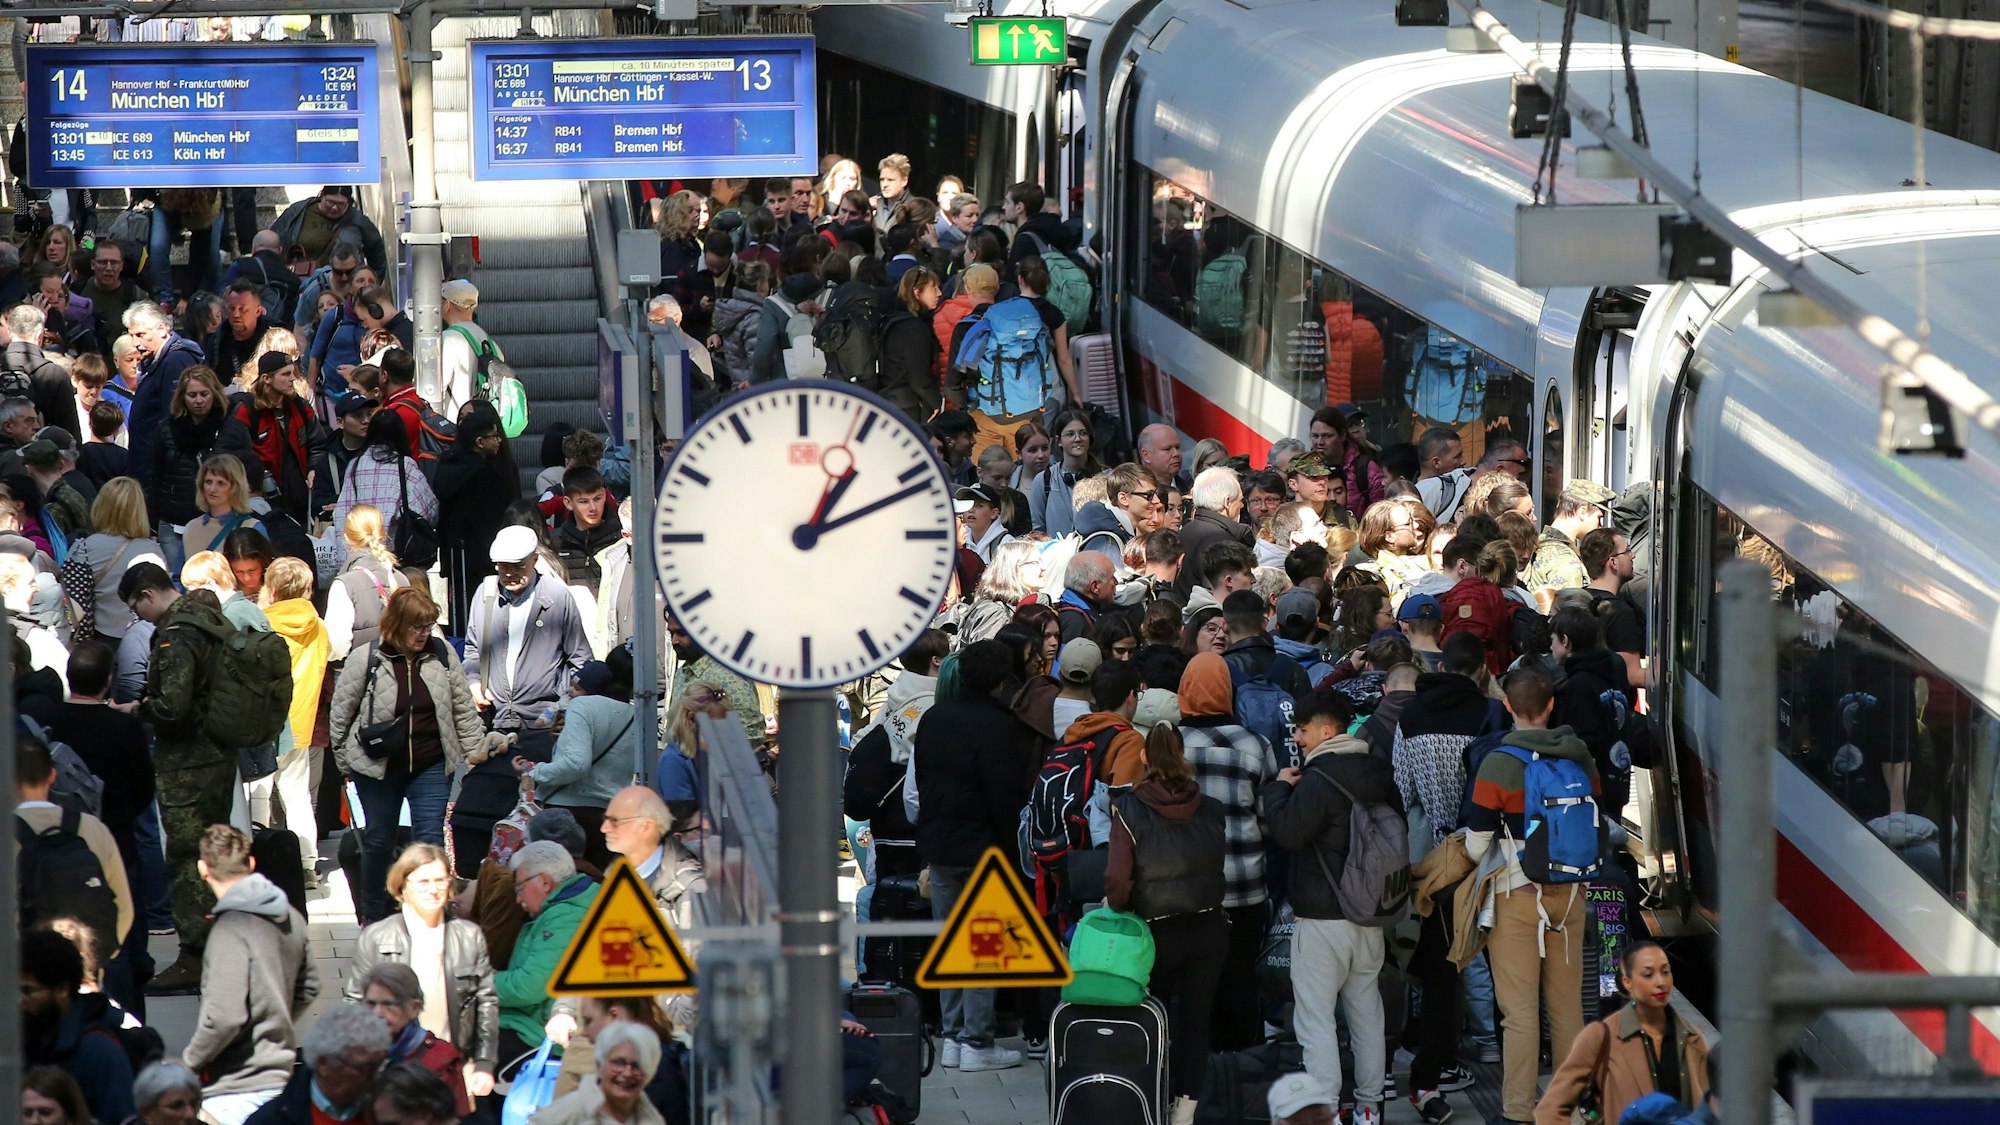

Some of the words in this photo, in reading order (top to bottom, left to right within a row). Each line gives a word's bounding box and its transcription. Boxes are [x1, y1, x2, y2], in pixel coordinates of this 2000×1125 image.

[496, 64, 529, 78] 13:01
[621, 62, 636, 70] ca.
[640, 61, 650, 69] 10
[653, 60, 694, 69] Minuten
[320, 67, 355, 81] 13:24
[554, 74, 595, 84] Hannover
[597, 73, 611, 83] Hbf
[619, 72, 662, 83] Göttingen
[669, 71, 714, 82] Kassel-W.
[735, 59, 771, 91] 13
[51, 70, 88, 101] 14
[111, 80, 153, 90] Hannover
[155, 79, 170, 89] Hbf
[179, 78, 250, 89] Frankfurt(M)Hbf
[325, 82, 339, 92] ICE
[340, 82, 356, 91] 691
[495, 79, 508, 89] ICE
[510, 79, 526, 88] 689
[554, 85, 630, 103] München
[636, 84, 665, 102] Hbf
[111, 91, 190, 110] München
[196, 91, 225, 109] Hbf
[50, 121, 89, 129] Folgezüge
[495, 126, 527, 138] 14:37
[555, 126, 582, 136] RB41
[614, 125, 658, 136] Bremen
[662, 124, 683, 135] Hbf
[52, 133, 84, 145] 13:01
[113, 133, 129, 143] ICE
[132, 133, 153, 143] 689
[174, 131, 226, 144] München
[230, 131, 250, 143] Hbf
[307, 129, 333, 138] Gleis
[337, 129, 348, 138] 13
[495, 143, 528, 155] 16:37
[555, 143, 582, 153] RB41
[614, 141, 659, 153] Bremen
[663, 140, 683, 152] Hbf
[52, 149, 85, 161] 13:45
[113, 150, 130, 160] ICE
[133, 149, 153, 160] 613
[174, 148, 201, 160] Köln
[204, 148, 226, 160] Hbf
[1280, 701, 1300, 768] adidas
[1585, 890, 1625, 902] PARIS
[1605, 923, 1626, 932] RIO
[1267, 956, 1291, 968] snipes
